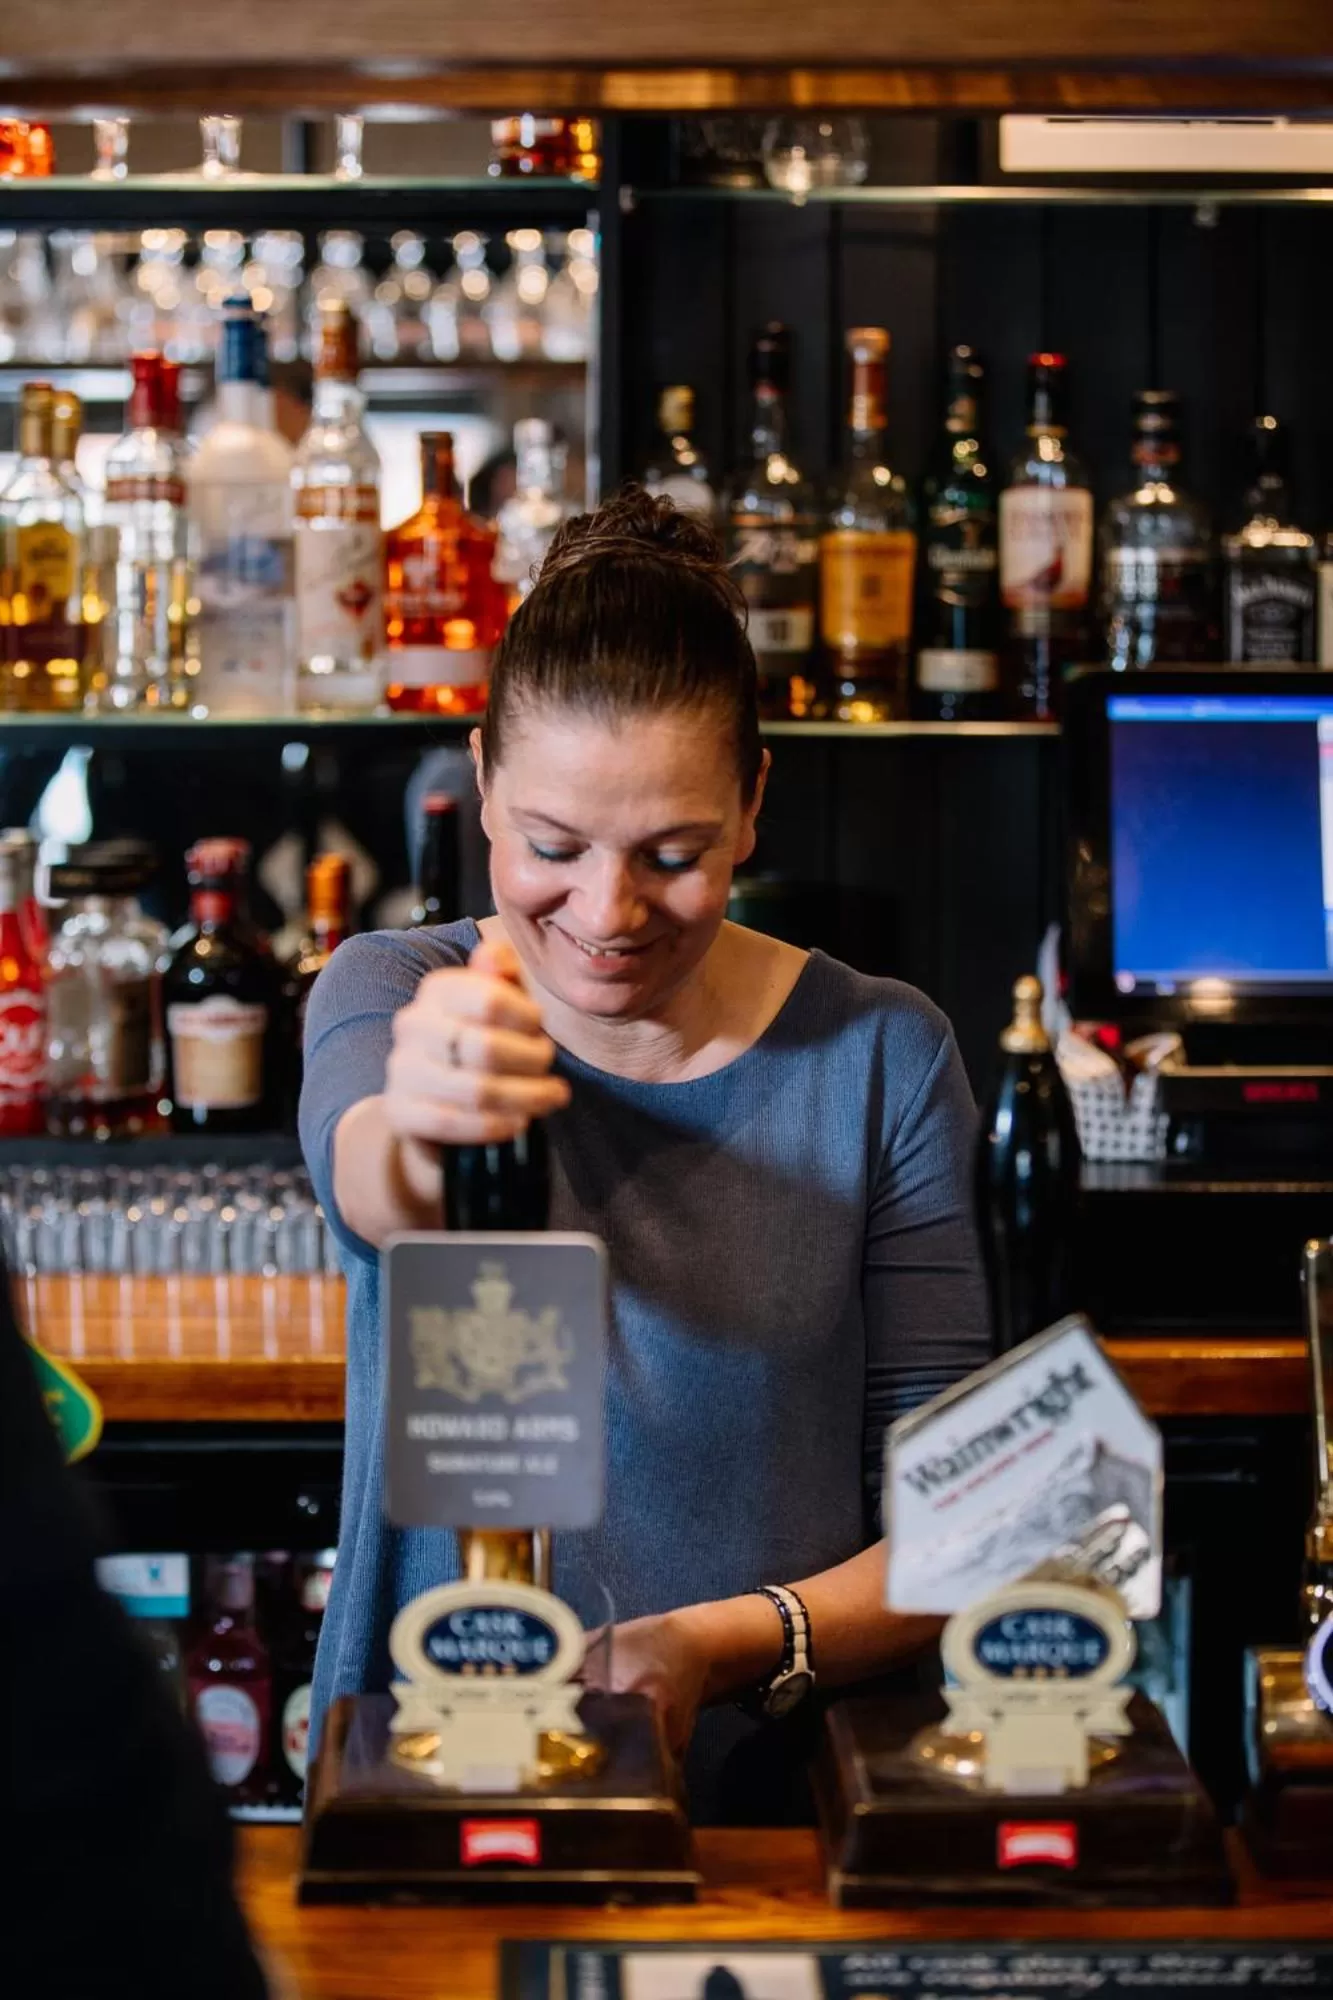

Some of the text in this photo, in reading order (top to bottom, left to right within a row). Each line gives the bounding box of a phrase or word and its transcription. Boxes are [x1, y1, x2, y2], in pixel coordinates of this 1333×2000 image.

[512, 1415, 579, 1442] ARMS
[904, 1361, 1096, 1497] Wainwright
[450, 1612, 526, 1637] CASK
[1001, 1614, 1076, 1640] CASK
[429, 1638, 549, 1664] MARQUE
[980, 1639, 1101, 1666] MARQUE
